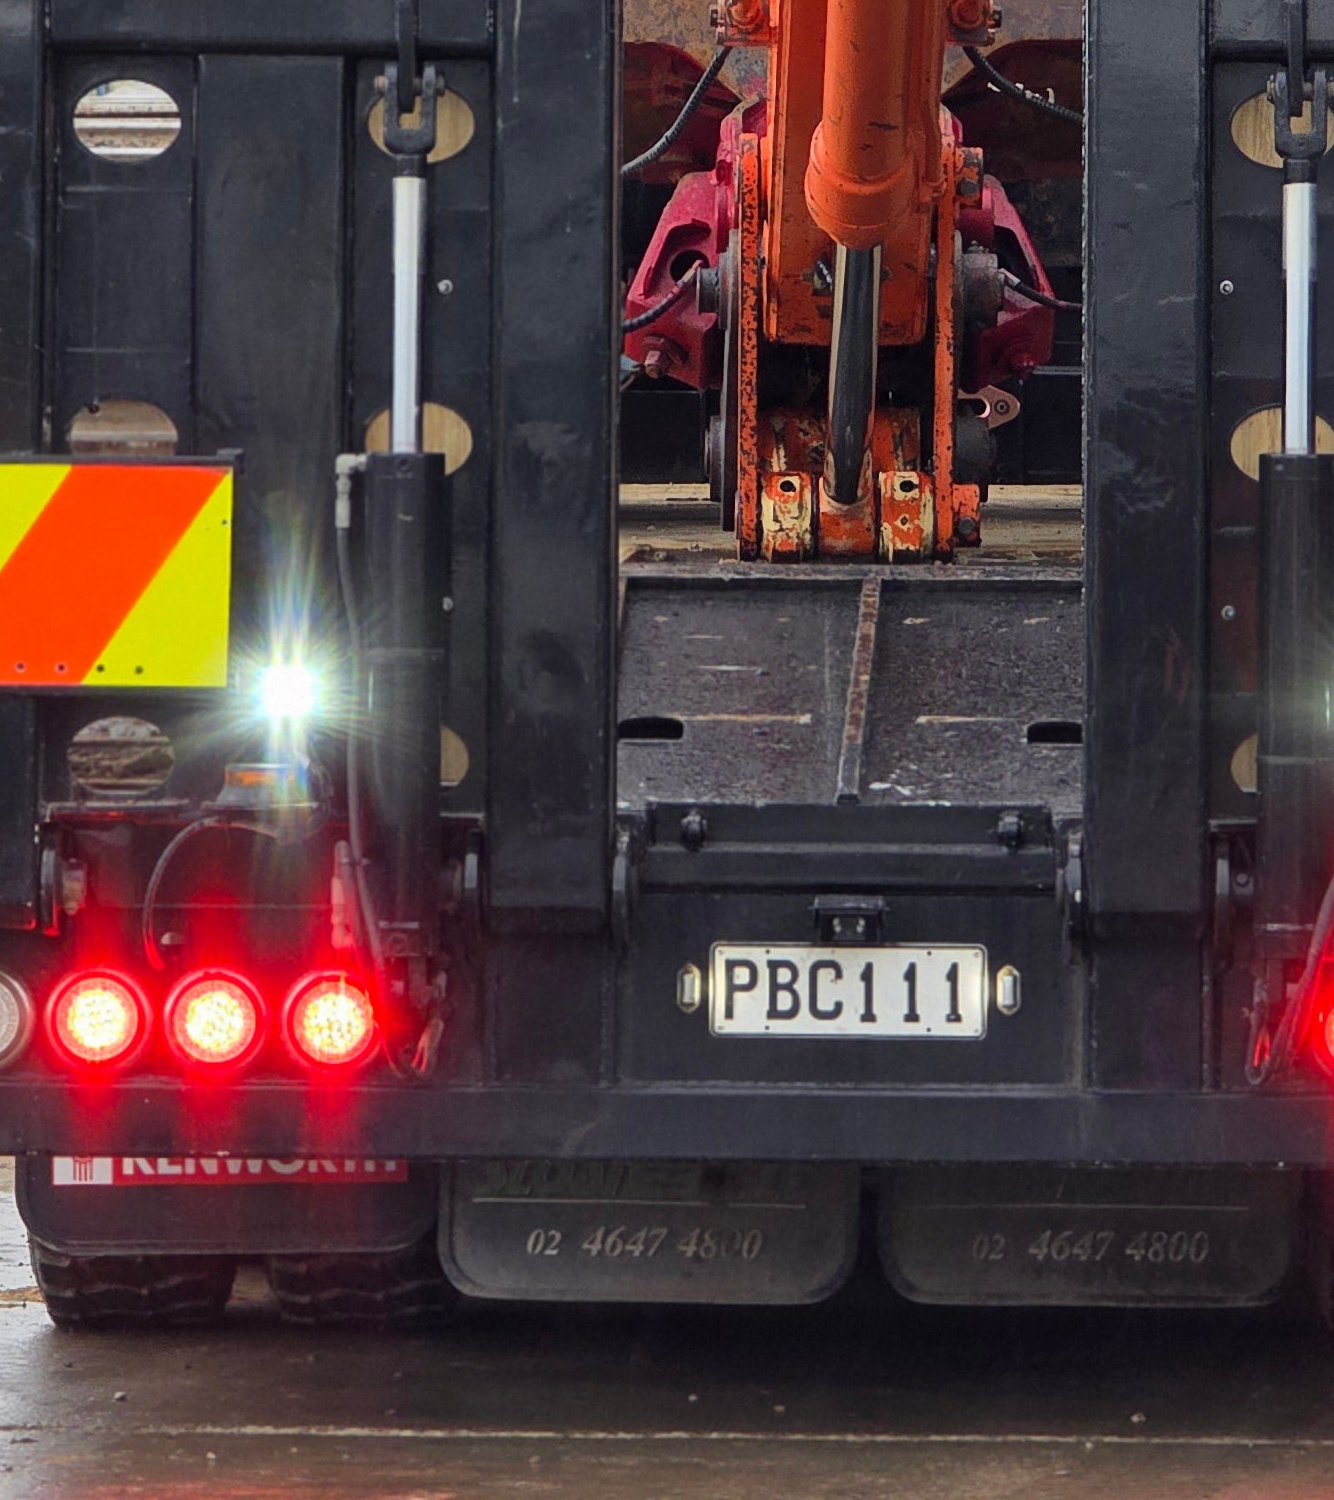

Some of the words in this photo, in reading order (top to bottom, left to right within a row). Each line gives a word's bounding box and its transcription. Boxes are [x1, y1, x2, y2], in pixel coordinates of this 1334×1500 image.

[724, 959, 961, 1022] PBC111
[526, 1229, 562, 1257] 02
[581, 1225, 667, 1259] 4647
[972, 1234, 1005, 1261] 02
[1028, 1229, 1114, 1262] 4647
[1125, 1231, 1209, 1263] 4800
